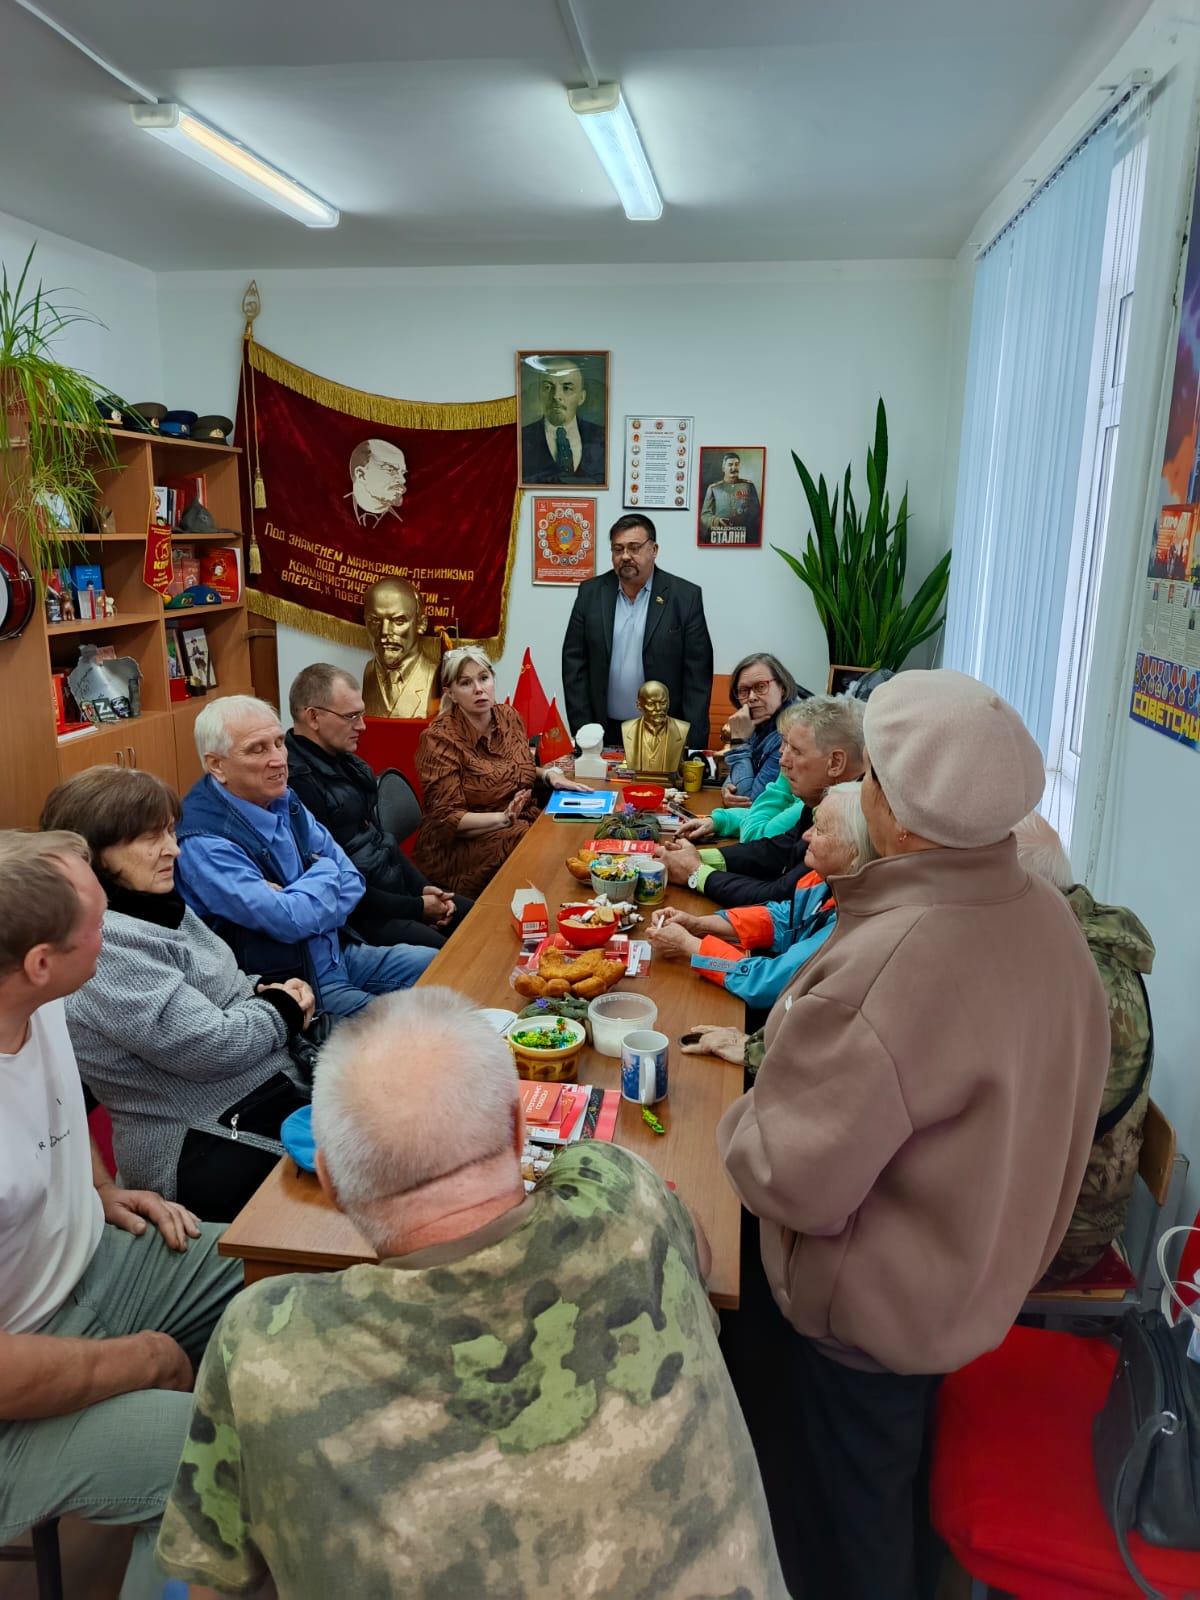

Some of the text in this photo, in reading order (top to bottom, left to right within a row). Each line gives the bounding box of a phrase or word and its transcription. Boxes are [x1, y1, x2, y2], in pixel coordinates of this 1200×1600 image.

[264, 522, 475, 582] Под ЗНАМЕНЕМ МАРКСИЗМА-ЛЕНИНИЗМА
[315, 558, 335, 573] ПОД
[281, 569, 324, 594] ВПЕРЕД,
[288, 559, 370, 594] КОММУНИСТИЧЕ
[1133, 691, 1200, 742] СОВЕТСКИ
